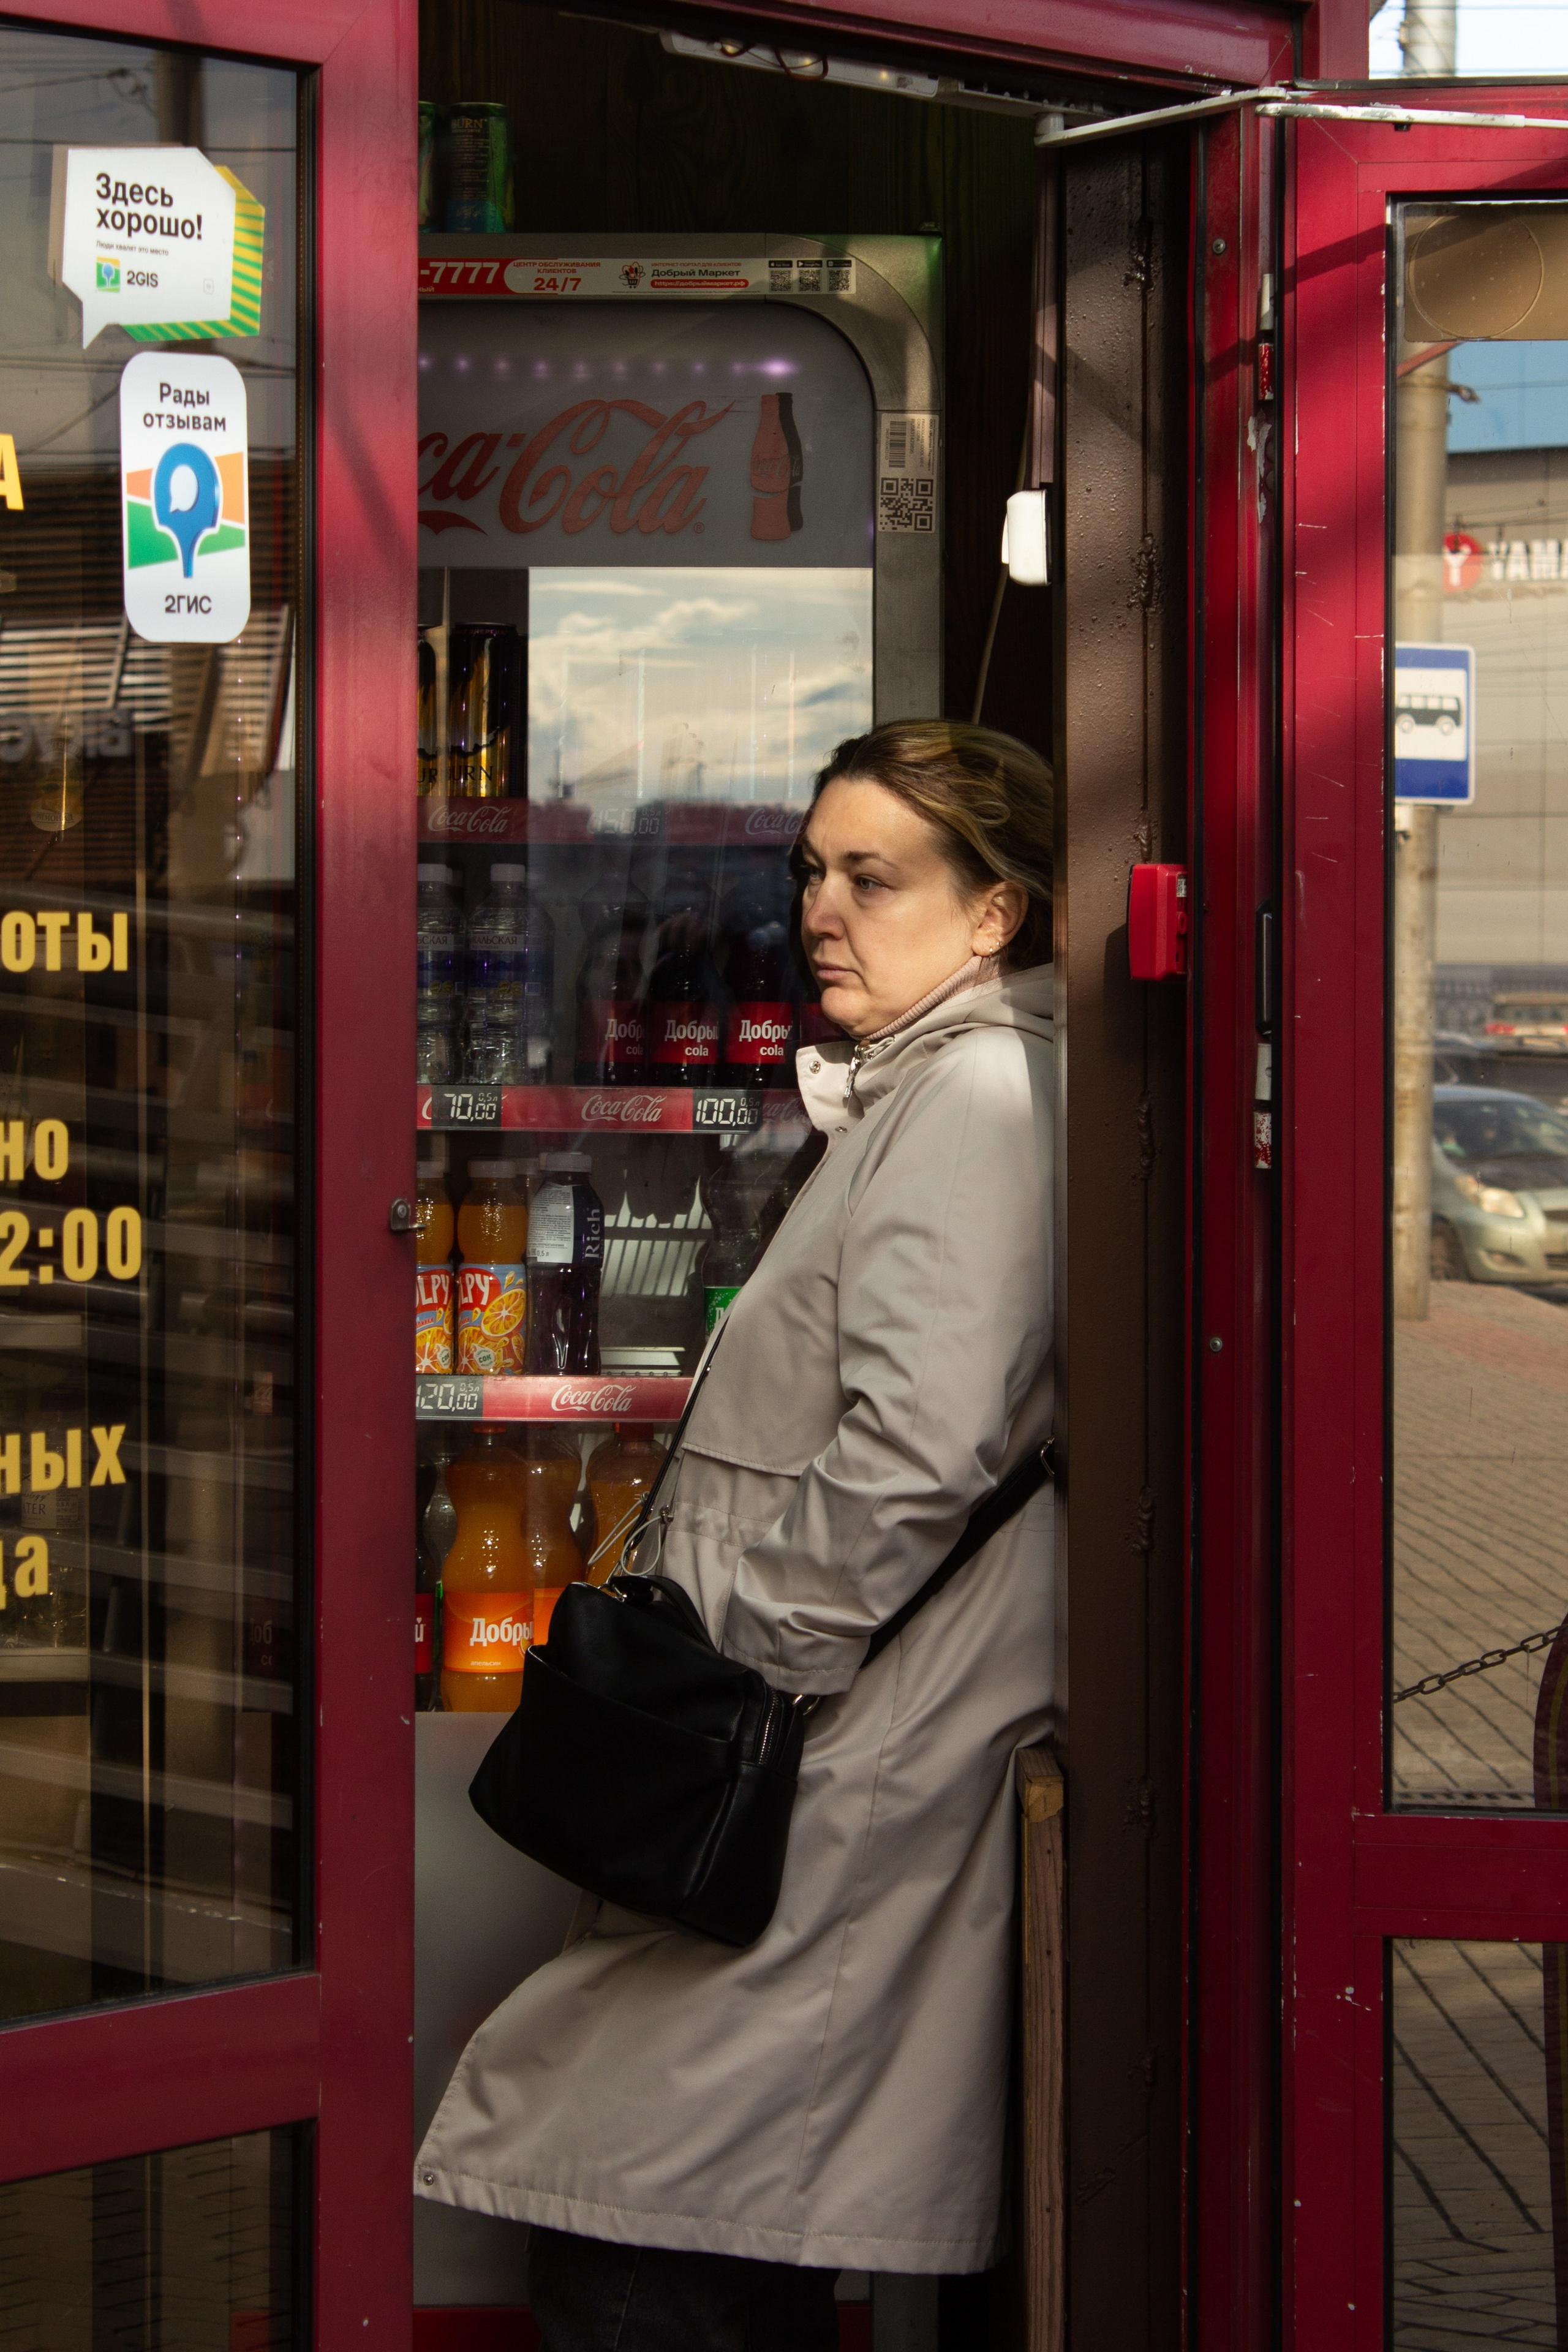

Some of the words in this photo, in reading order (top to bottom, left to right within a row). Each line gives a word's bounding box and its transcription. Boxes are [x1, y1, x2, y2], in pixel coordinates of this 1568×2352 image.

[96, 173, 173, 207] Здесь
[96, 208, 202, 240] хорошо!
[96, 240, 114, 249] Люди
[127, 270, 159, 288] 2GIS
[533, 277, 582, 292] 24/7
[651, 269, 695, 277] Добрый
[160, 382, 209, 408] Рады
[143, 413, 226, 432] отзывам
[165, 595, 212, 615] 2ГИС
[429, 805, 513, 834] Coca-Cola
[685, 1044, 709, 1056] cola
[760, 1044, 784, 1056] cola
[443, 1093, 497, 1122] 70,00
[581, 1095, 667, 1122] Coca-Cola
[696, 1098, 758, 1127] 100,00
[584, 1208, 600, 1258] Rich
[417, 1274, 450, 1306] LPY
[478, 1354, 492, 1363] СОК
[551, 1384, 637, 1412] Coca-Cola
[469, 1616, 533, 1647] Добры
